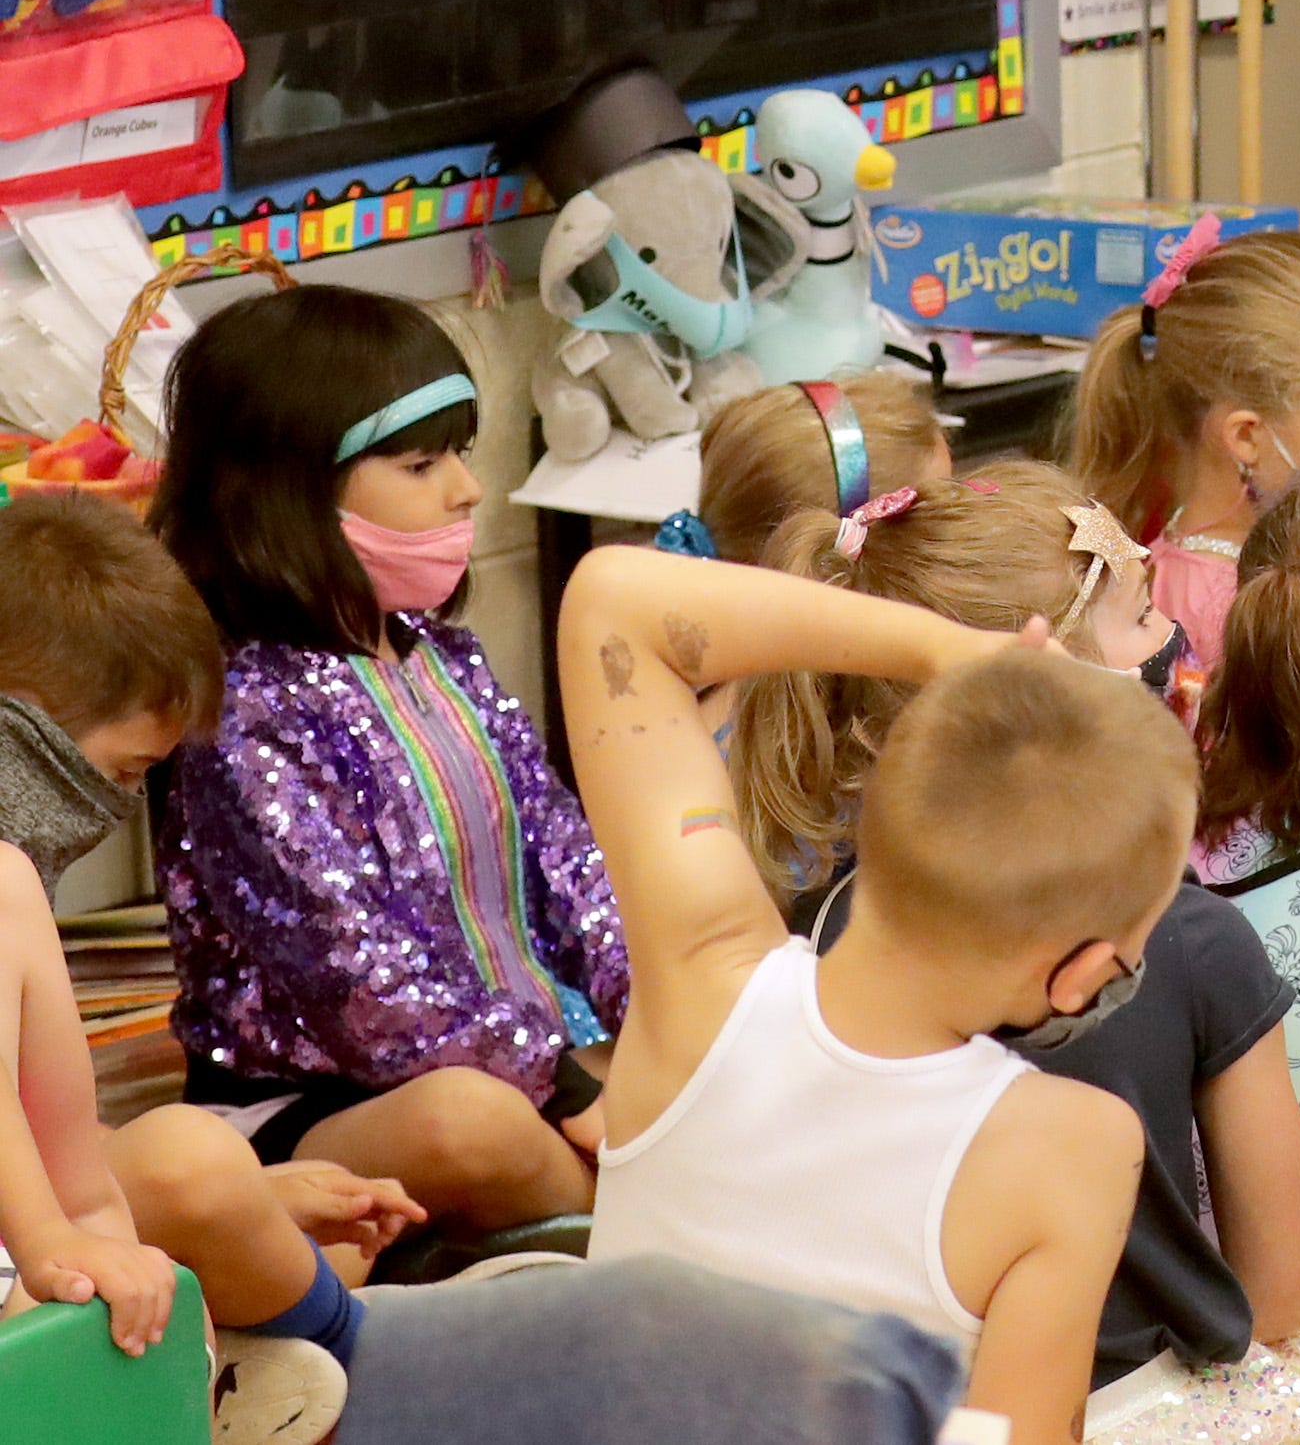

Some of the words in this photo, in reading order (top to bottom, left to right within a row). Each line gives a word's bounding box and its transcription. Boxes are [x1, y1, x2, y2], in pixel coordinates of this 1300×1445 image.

[92, 123, 127, 139] Orange
[129, 119, 157, 132] Cubes
[933, 229, 1073, 302] Zingo!
